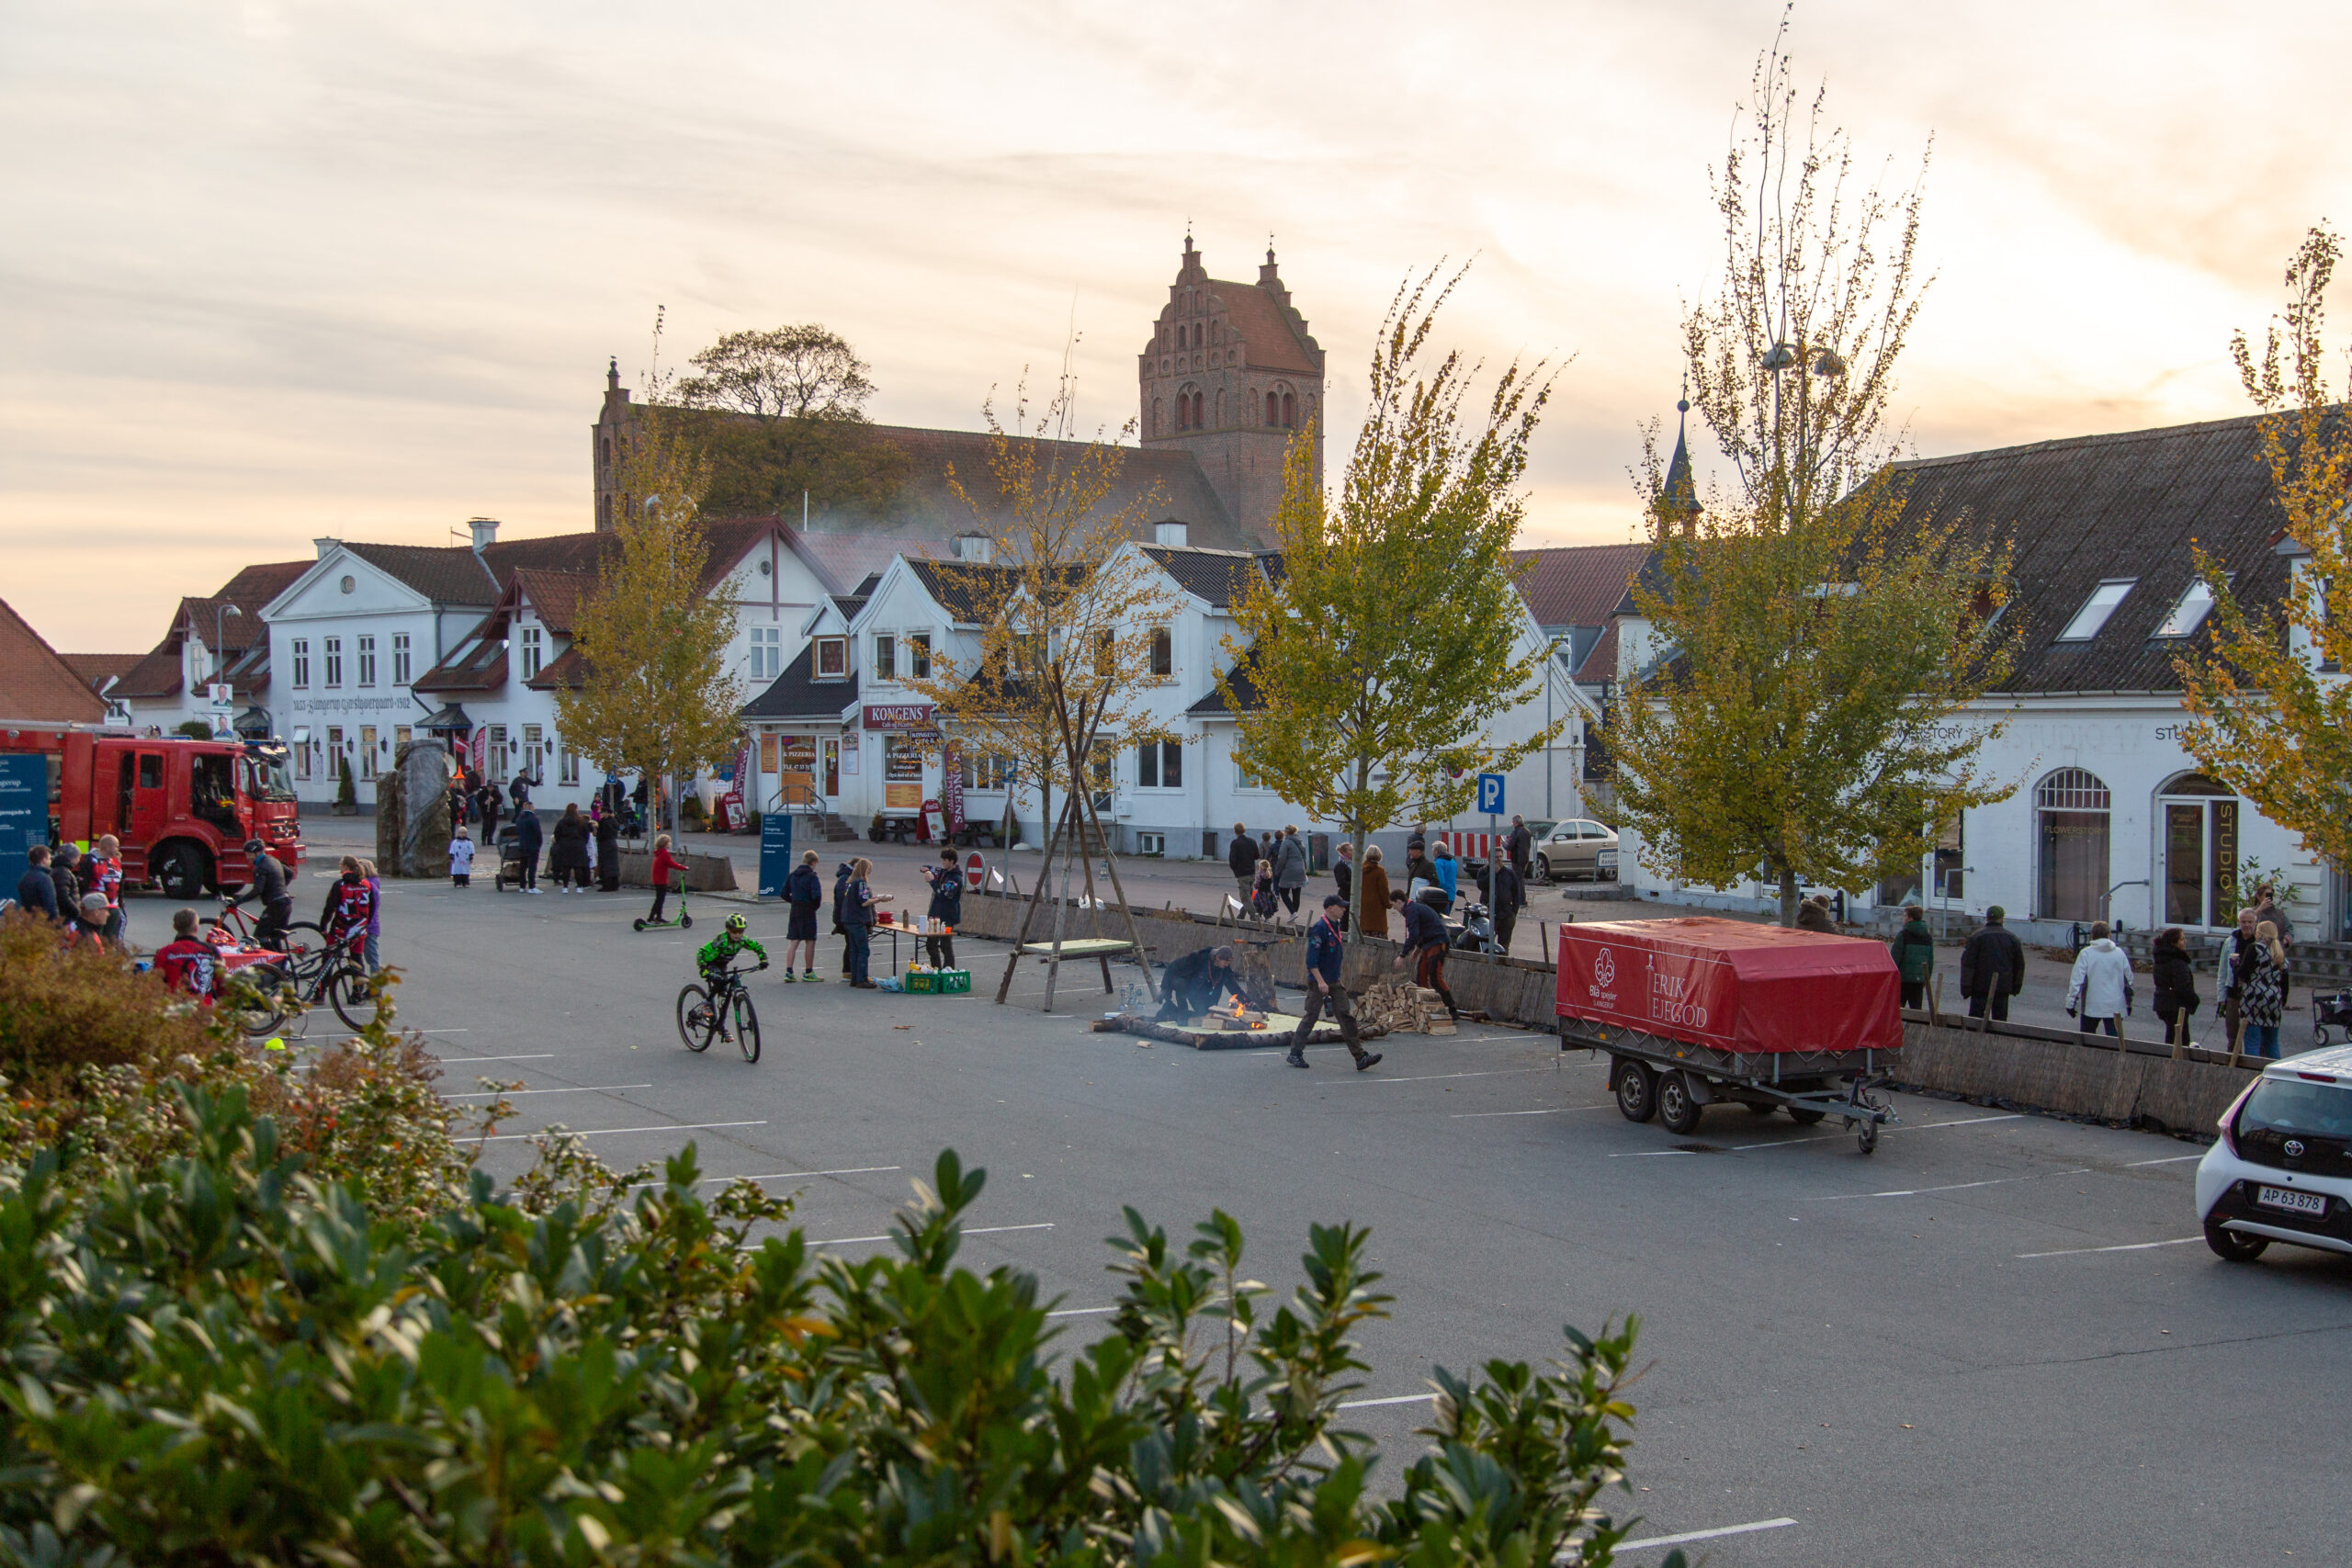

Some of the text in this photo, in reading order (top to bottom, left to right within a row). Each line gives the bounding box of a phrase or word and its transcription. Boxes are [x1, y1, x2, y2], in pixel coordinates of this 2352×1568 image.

[397, 697, 411, 709] 1902
[872, 706, 923, 721] KONGENS
[1884, 727, 1963, 739] OWERSTORY
[953, 750, 963, 823] KNGENS
[1485, 778, 1500, 809] P
[1589, 984, 1617, 1001] Blå spejder
[1653, 973, 1686, 998] ERIK
[1652, 998, 1708, 1028] EJEGOD
[2263, 1189, 2320, 1210] AP 63 878
